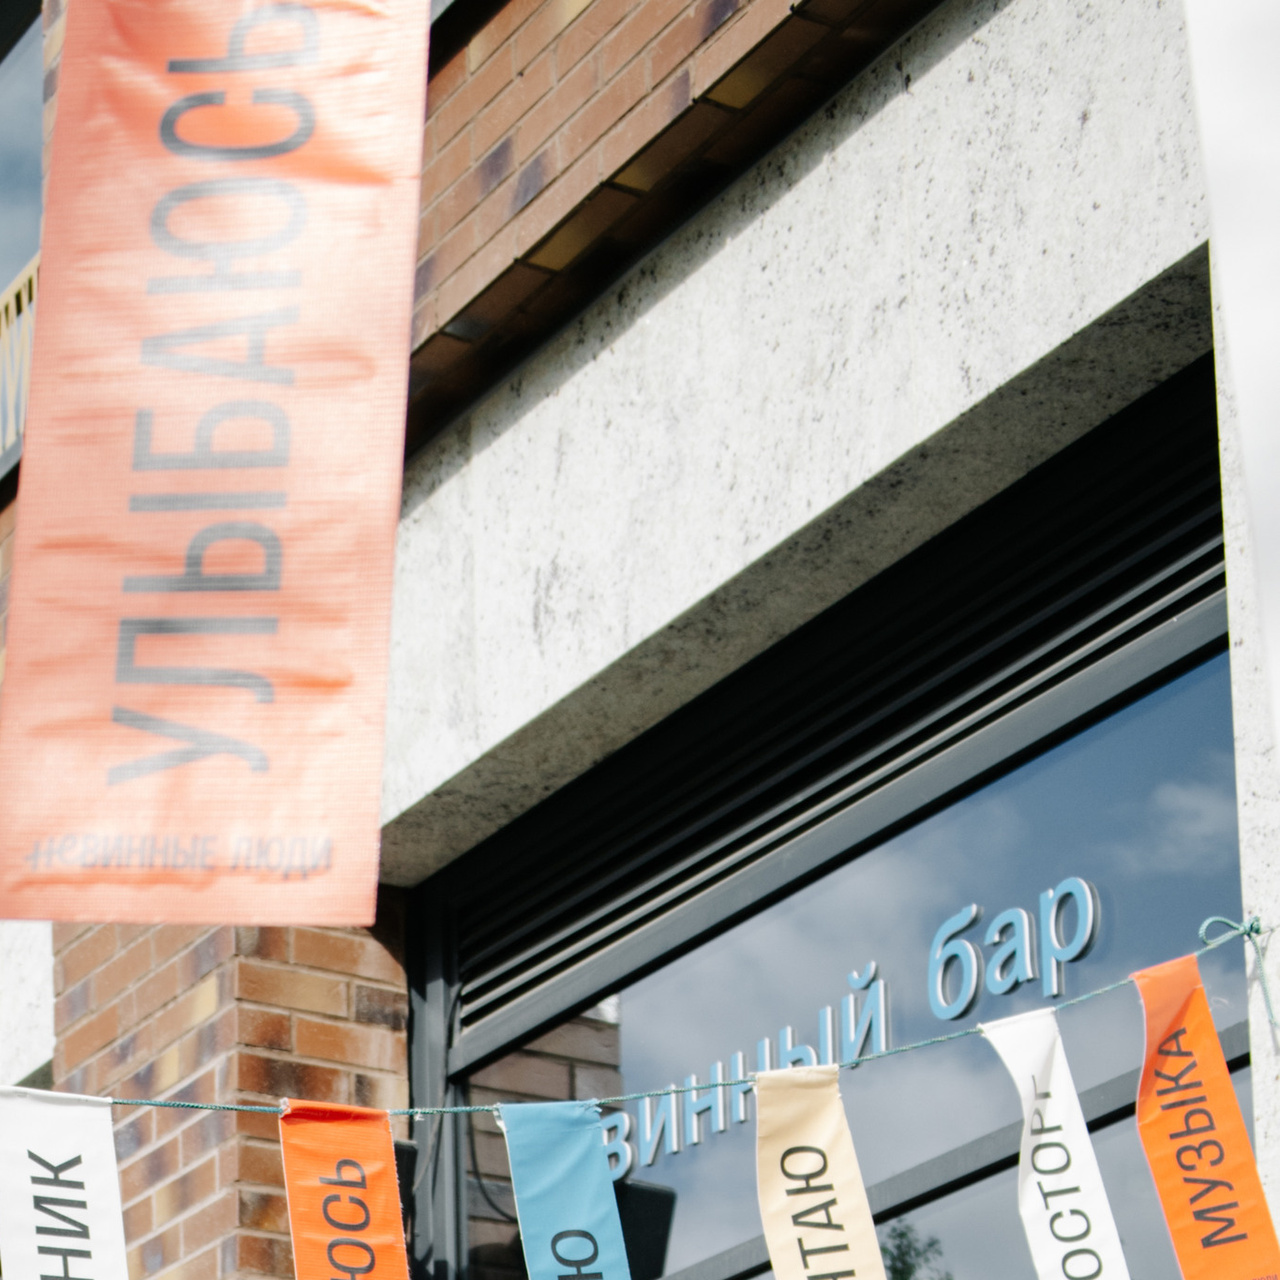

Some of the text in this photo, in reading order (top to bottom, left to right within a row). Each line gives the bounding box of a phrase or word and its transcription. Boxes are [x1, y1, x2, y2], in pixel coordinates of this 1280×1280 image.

[108, 0, 321, 786] УЛЫБАЮСЬ
[231, 835, 334, 883] ЛЮДИ
[928, 877, 1098, 1020] бар
[1154, 1027, 1248, 1249] МУЗЫКА
